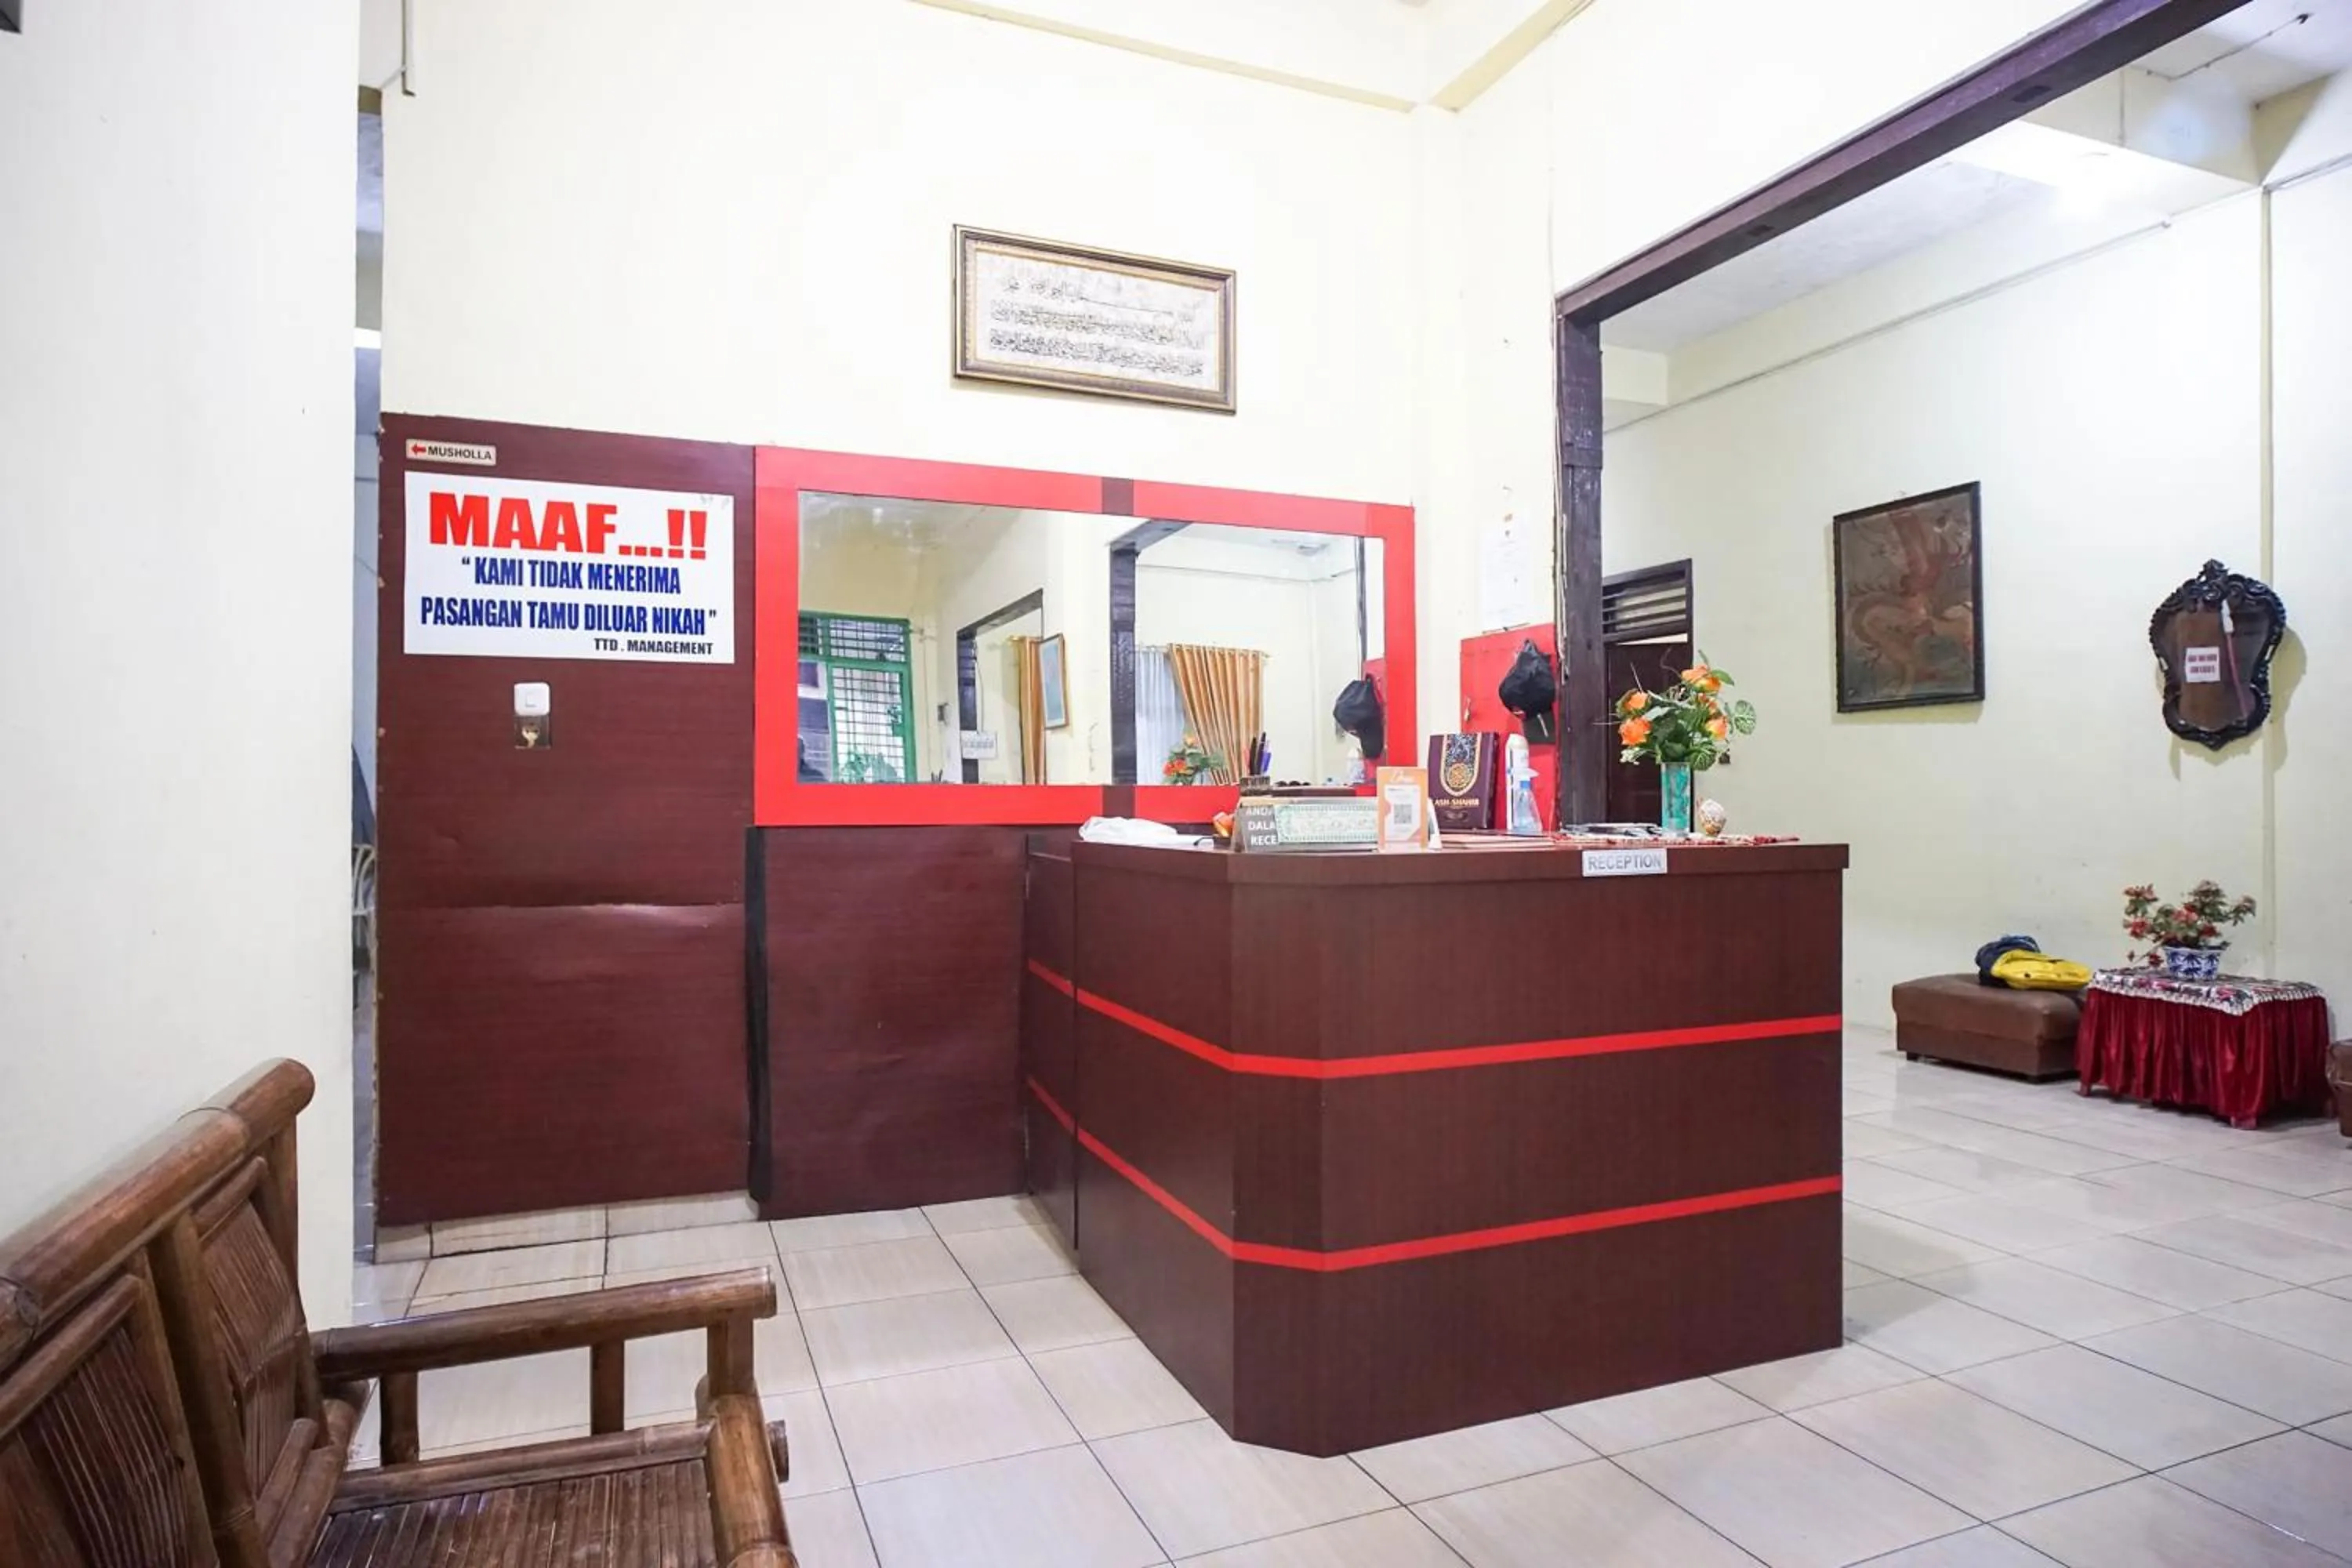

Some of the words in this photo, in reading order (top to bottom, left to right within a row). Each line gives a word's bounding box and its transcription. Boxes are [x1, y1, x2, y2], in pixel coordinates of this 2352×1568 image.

[427, 445, 492, 460] MUSHOLLA
[430, 492, 707, 560] MAAF...!!
[528, 559, 583, 590] TIDAK
[587, 563, 681, 594] MENERIMA
[421, 596, 522, 627] PASANGAN
[526, 601, 579, 631] TAMU
[584, 603, 648, 633] DILUAR
[626, 639, 713, 655] MANAGEMENT
[1588, 855, 1661, 871] RECEPTION
